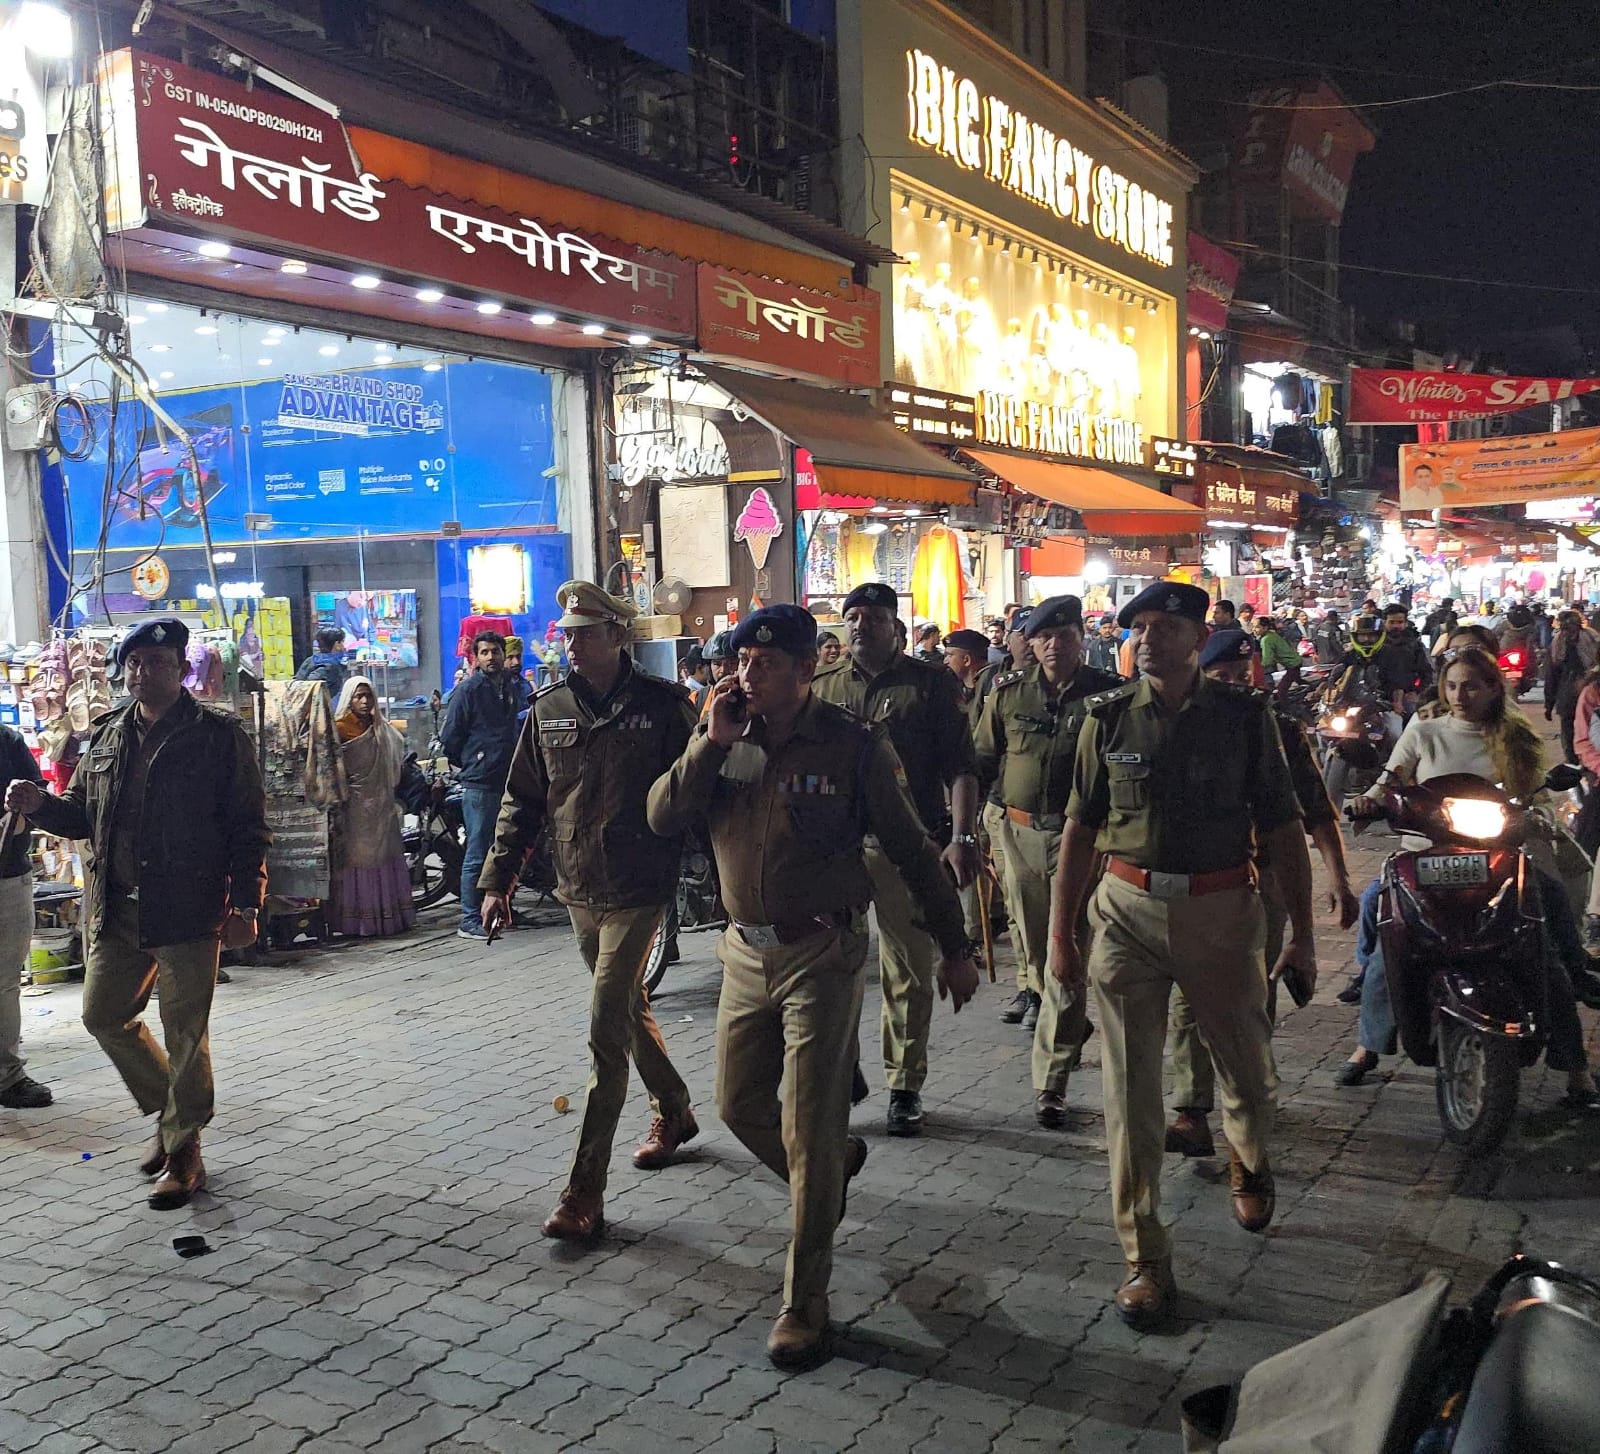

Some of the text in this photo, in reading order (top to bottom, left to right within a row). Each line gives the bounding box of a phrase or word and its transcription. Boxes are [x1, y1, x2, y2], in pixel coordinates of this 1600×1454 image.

[164, 83, 192, 103] GST
[906, 48, 981, 170] BIG
[983, 96, 1093, 226] FANCY
[1093, 165, 1174, 268] STORE
[174, 117, 678, 299] गेलॉर्ड एम्पोरियम
[714, 275, 868, 348] गेलॉर्ड
[278, 385, 424, 431] ADVANTAGE
[331, 374, 385, 398] BRAND
[386, 381, 423, 403] SHOP
[1380, 376, 1482, 403] Winter
[976, 390, 1022, 448] BIG
[1022, 400, 1088, 459] FANCY
[1089, 413, 1145, 466] STORE
[797, 472, 812, 486] BIG
